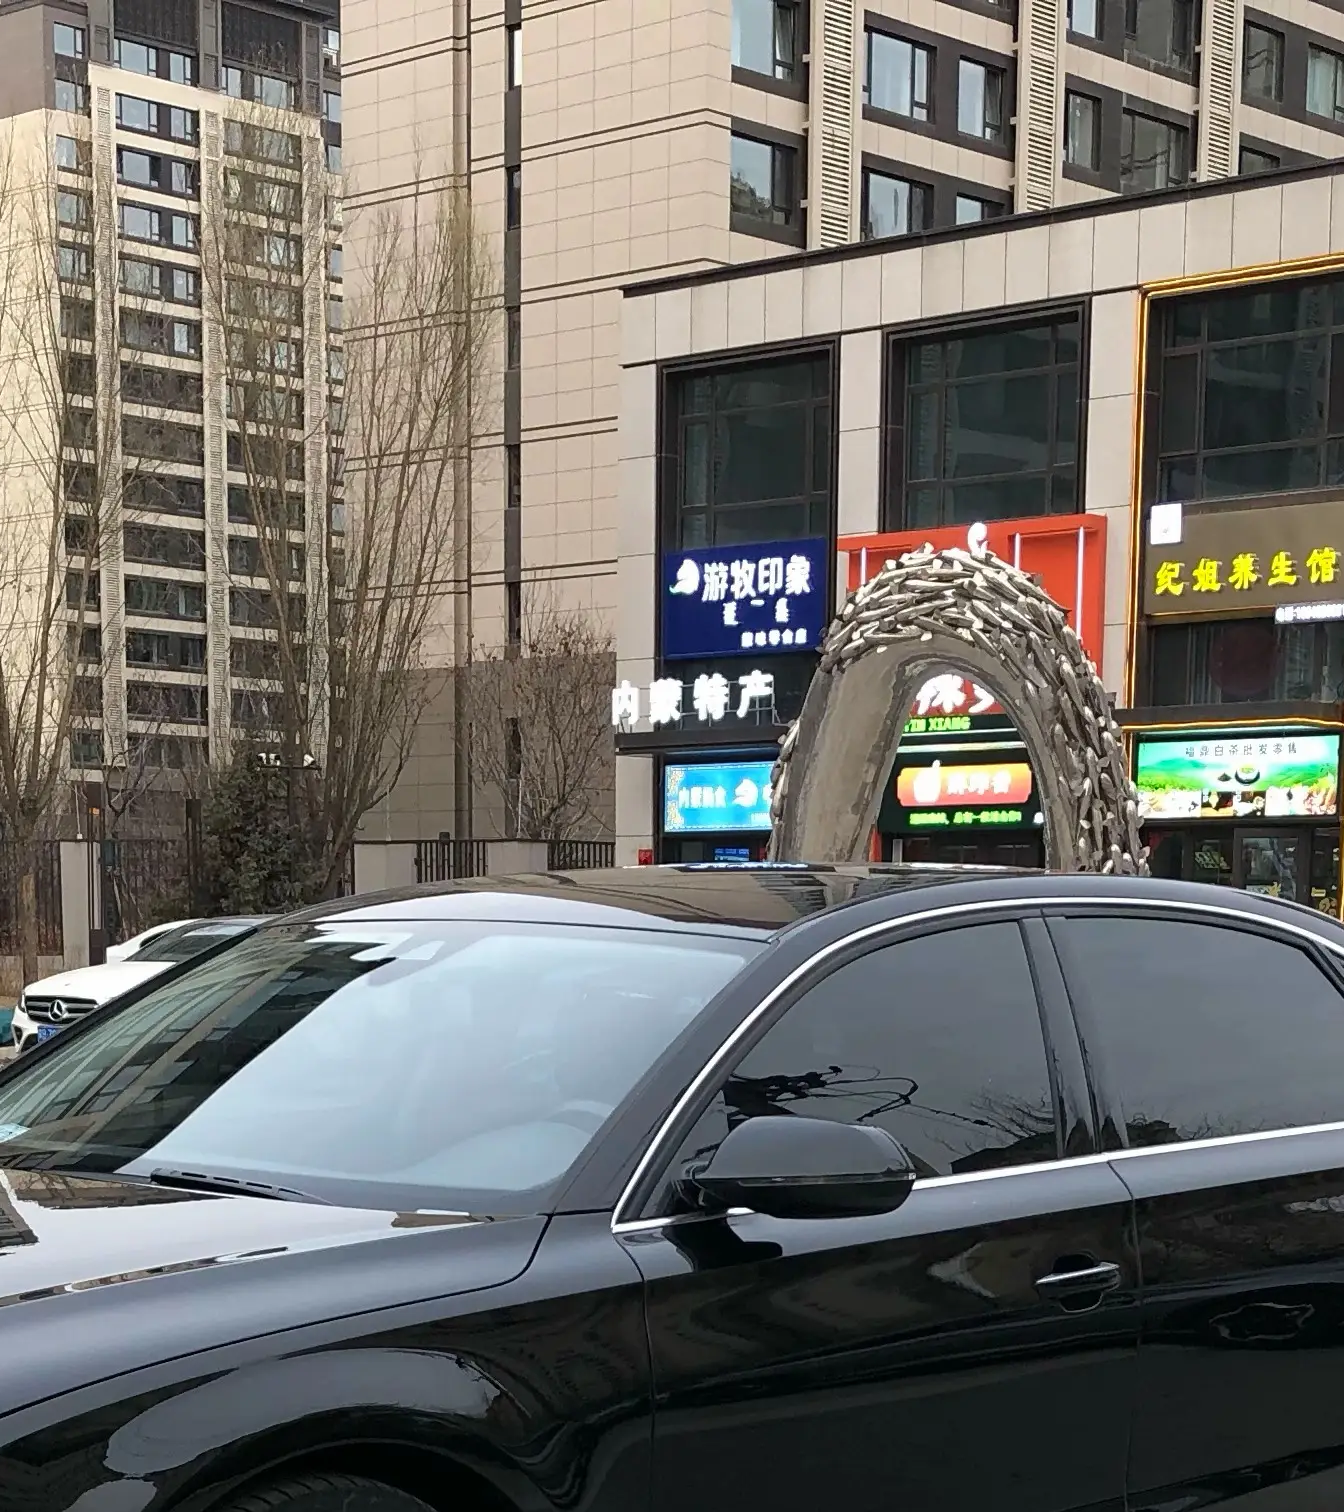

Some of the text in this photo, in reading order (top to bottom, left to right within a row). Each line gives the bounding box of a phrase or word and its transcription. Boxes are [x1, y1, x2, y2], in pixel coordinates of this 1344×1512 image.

[702, 554, 810, 602] 游牧印象
[1155, 546, 1337, 596] 纪姐养生馆
[612, 669, 775, 725] 内蒙特产
